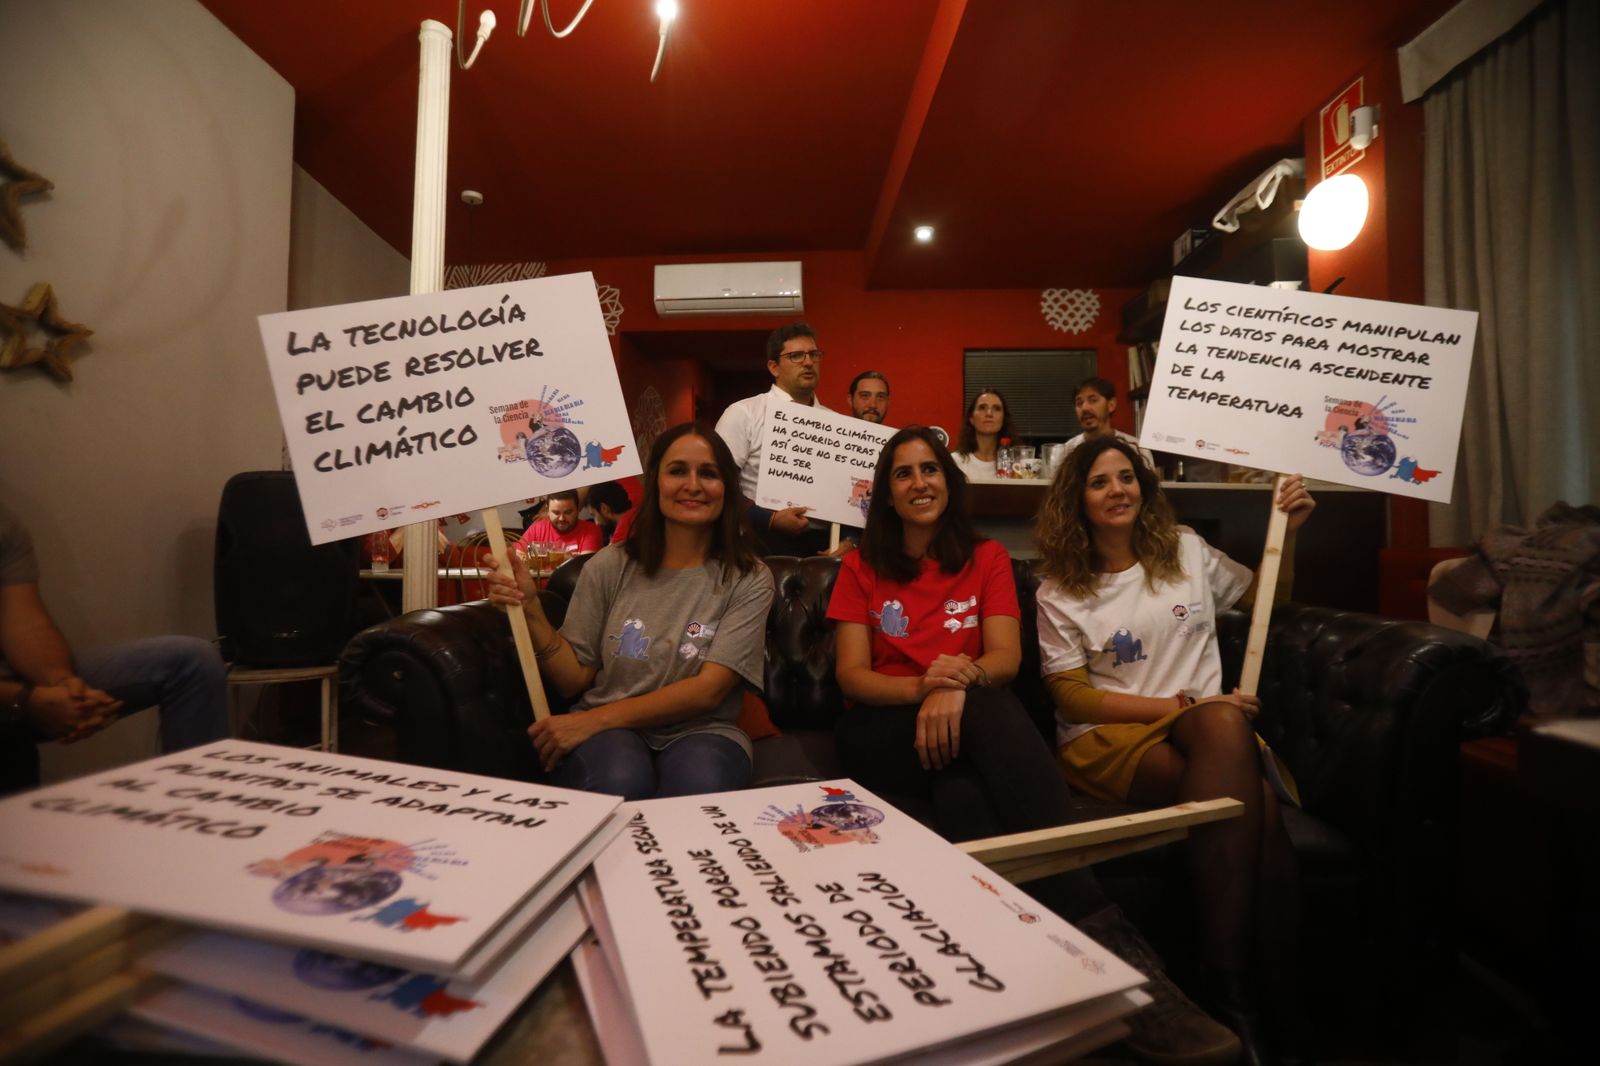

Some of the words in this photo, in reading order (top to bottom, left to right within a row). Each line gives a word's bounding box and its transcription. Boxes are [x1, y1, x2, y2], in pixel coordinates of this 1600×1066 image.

[287, 332, 331, 356] LA
[343, 295, 526, 347] TECNOLOGÍA
[1180, 320, 1215, 333] LOS
[1220, 326, 1276, 342] DATOS
[1282, 334, 1329, 350] PARA
[1337, 342, 1429, 365] MOSTRAR
[1184, 298, 1221, 313] LOS
[1226, 306, 1337, 328] CIENTÍFICOS
[1342, 320, 1461, 345] MANIPULAN
[297, 361, 391, 395] PUEDE
[406, 338, 543, 377] RESOLVER
[1171, 364, 1194, 376] DE
[1201, 368, 1225, 382] LA
[1176, 342, 1197, 354] LA
[1207, 347, 1301, 370] TENDENCIA
[1309, 362, 1432, 389] ASCENDENTE
[306, 410, 344, 434] EL
[357, 386, 474, 424] CAMBIO
[489, 402, 519, 414] Semana
[519, 400, 529, 409] de
[494, 416, 502, 424] la
[502, 411, 529, 423] Ciencia
[1168, 386, 1303, 418] TEMPERATURA
[314, 425, 477, 472] CLIMÁTICO
[771, 439, 791, 449] ASÍ
[792, 445, 813, 455] QUE
[816, 450, 830, 459] NO
[835, 455, 847, 463] ES
[773, 426, 787, 435] HA
[791, 430, 840, 447] OCURRIDO
[844, 443, 875, 455] OTRAS
[774, 411, 788, 421] EL
[793, 417, 832, 432] CAMBIO
[836, 427, 887, 447] CLIMÁTICO
[768, 468, 813, 484] HUMANO
[770, 453, 788, 464] DEL
[793, 459, 811, 469] SER
[100, 777, 150, 793] AL
[166, 784, 321, 817] CAMBIO
[155, 763, 309, 793] PLANTAS
[317, 787, 371, 800] SE
[372, 796, 547, 828] ADAPTAN
[202, 750, 270, 765] LOS
[291, 761, 459, 793] ANIMALES
[462, 785, 491, 797] Y
[492, 793, 569, 809] LAS
[31, 797, 268, 839] CLIMÁTICO
[701, 806, 726, 818] UN
[713, 822, 741, 835] DE
[687, 849, 747, 908] PORQUE
[728, 838, 801, 907] SALIENDO
[815, 882, 854, 904] DE
[645, 859, 733, 1000] TEMPERATURA
[858, 873, 1005, 992] GLACIACIÓN
[730, 917, 830, 1041] SUBIENDO
[784, 913, 893, 1023] ESTAMOS
[843, 910, 952, 1007] PERIODO
[713, 1009, 762, 1055] LA
